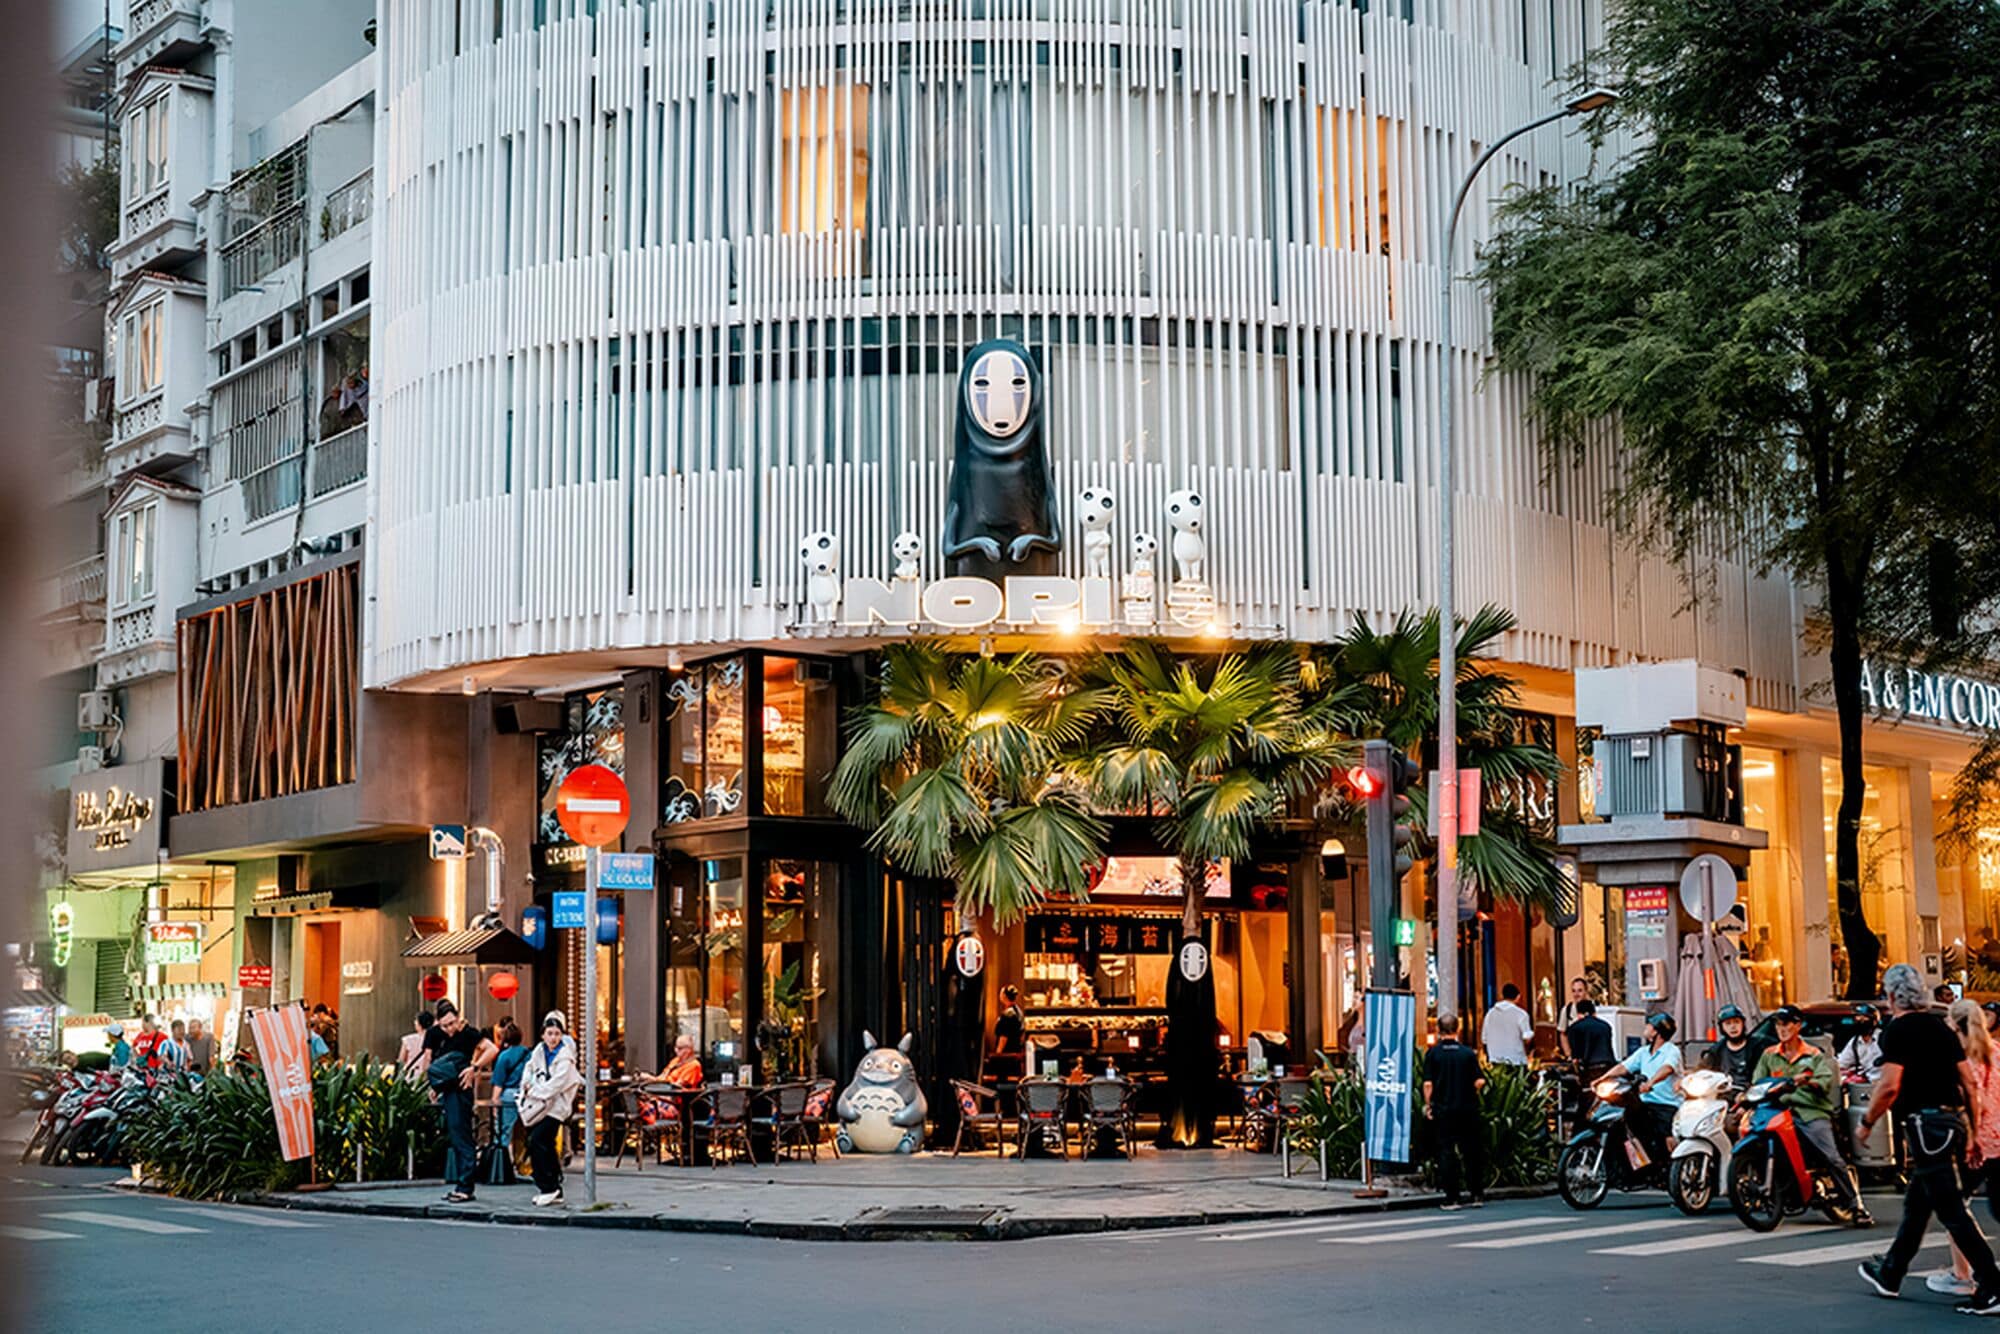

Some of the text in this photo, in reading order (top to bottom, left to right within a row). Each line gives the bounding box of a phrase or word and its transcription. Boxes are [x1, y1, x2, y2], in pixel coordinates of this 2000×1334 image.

[844, 575, 1111, 627] NORI
[1883, 670, 1900, 710] &
[1906, 668, 1947, 720] EM
[1951, 678, 2000, 730] COR
[1366, 1079, 1406, 1094] NORI
